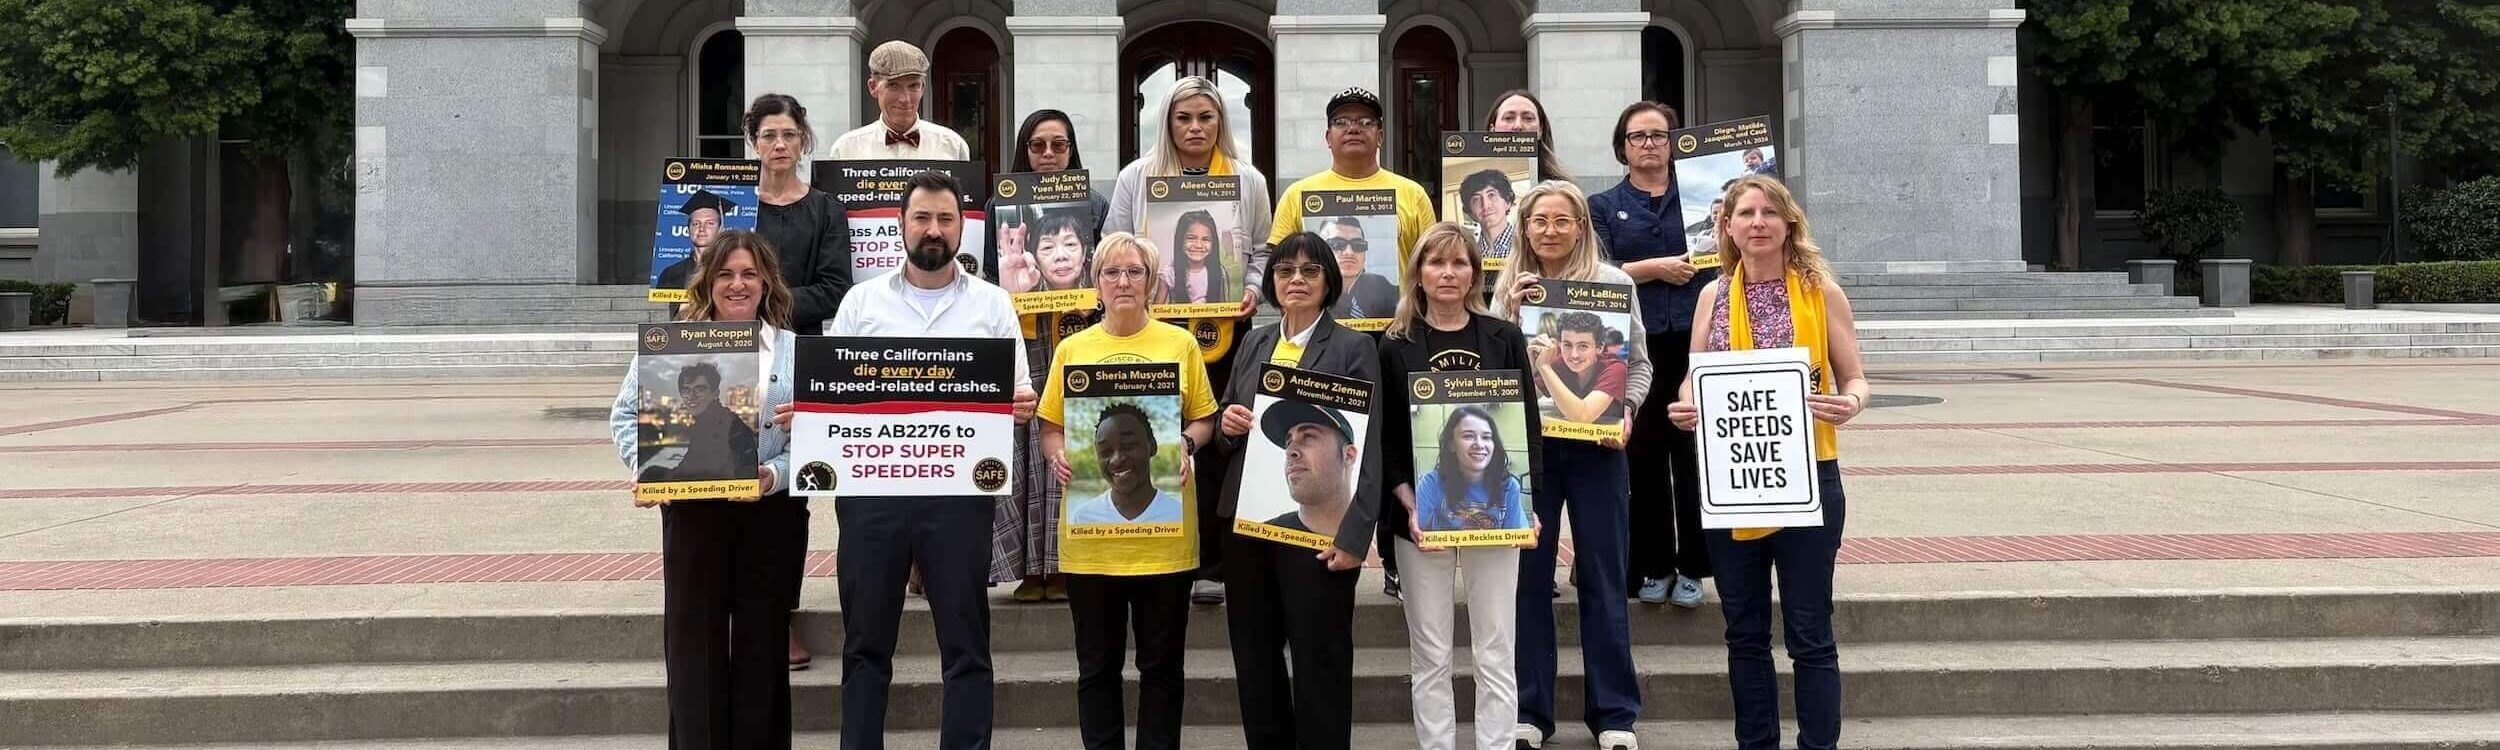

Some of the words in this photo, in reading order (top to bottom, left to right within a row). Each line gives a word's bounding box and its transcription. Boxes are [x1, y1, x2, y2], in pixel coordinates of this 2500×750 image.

[1512, 136, 1534, 144] Lopez
[1724, 140, 1742, 148] March
[690, 162, 713, 171] Misha
[705, 174, 730, 182] January
[842, 168, 877, 178] Three
[857, 179, 876, 189] die
[1040, 175, 1060, 184] Judy
[1063, 174, 1086, 182] Szeto
[1032, 185, 1053, 193] Yuen
[1181, 181, 1206, 189] Aileen
[1336, 195, 1353, 203] Paul
[850, 241, 888, 252] STOP
[673, 292, 682, 300] by
[1044, 294, 1068, 302] Injured
[1567, 287, 1588, 298] Kyle
[1591, 289, 1628, 300] LaBlanc
[1023, 302, 1054, 310] Speeding
[1568, 299, 1594, 308] January
[646, 335, 666, 343] SAFE
[680, 329, 706, 340] Ryan
[709, 328, 753, 339] Koeppel
[1197, 330, 1217, 340] SAFE
[697, 341, 723, 349] August
[835, 348, 879, 361] Three
[883, 348, 974, 362] Californians
[854, 363, 878, 376] die
[881, 366, 923, 379] every
[927, 364, 955, 379] day
[1095, 370, 1127, 380] Sheria
[1130, 369, 1175, 381] Musyoka
[810, 378, 825, 392] in
[829, 380, 934, 394] speed-related
[938, 380, 1000, 393] crashes.
[1114, 383, 1146, 391] February
[1148, 382, 1156, 390] 4,
[1289, 375, 1329, 390] Andrew
[1331, 382, 1368, 398] Zieman
[1444, 379, 1473, 389] Sylvia
[1475, 377, 1518, 389] Bingham
[1297, 388, 1333, 401] November
[1334, 395, 1346, 404] 21,
[1348, 398, 1365, 407] 2021
[1447, 390, 1486, 398] September
[1727, 390, 1778, 412] SAFE
[828, 424, 872, 438] Pass
[878, 424, 951, 438] AB2276
[956, 425, 975, 438] to
[1558, 425, 1594, 436] Speeding
[1596, 428, 1621, 437] Driver
[1716, 415, 1793, 438] SPEEDS
[842, 444, 894, 458] STOP
[900, 444, 965, 458] SUPER
[1730, 441, 1783, 464] SAVE
[851, 464, 955, 479] SPEEDERS
[975, 470, 1005, 480] SAFE
[1730, 467, 1787, 490] LIVES
[642, 486, 666, 494] Killed
[668, 487, 678, 496] by
[687, 485, 726, 494] Speeding
[1071, 527, 1094, 535] Killed
[1095, 527, 1105, 536] by
[1115, 526, 1153, 535] Speeding
[1238, 522, 1260, 534] Killed
[1262, 527, 1272, 537] by
[1280, 531, 1317, 546] Speeding
[1450, 534, 1459, 543] by
[1469, 533, 1503, 541] Reckless
